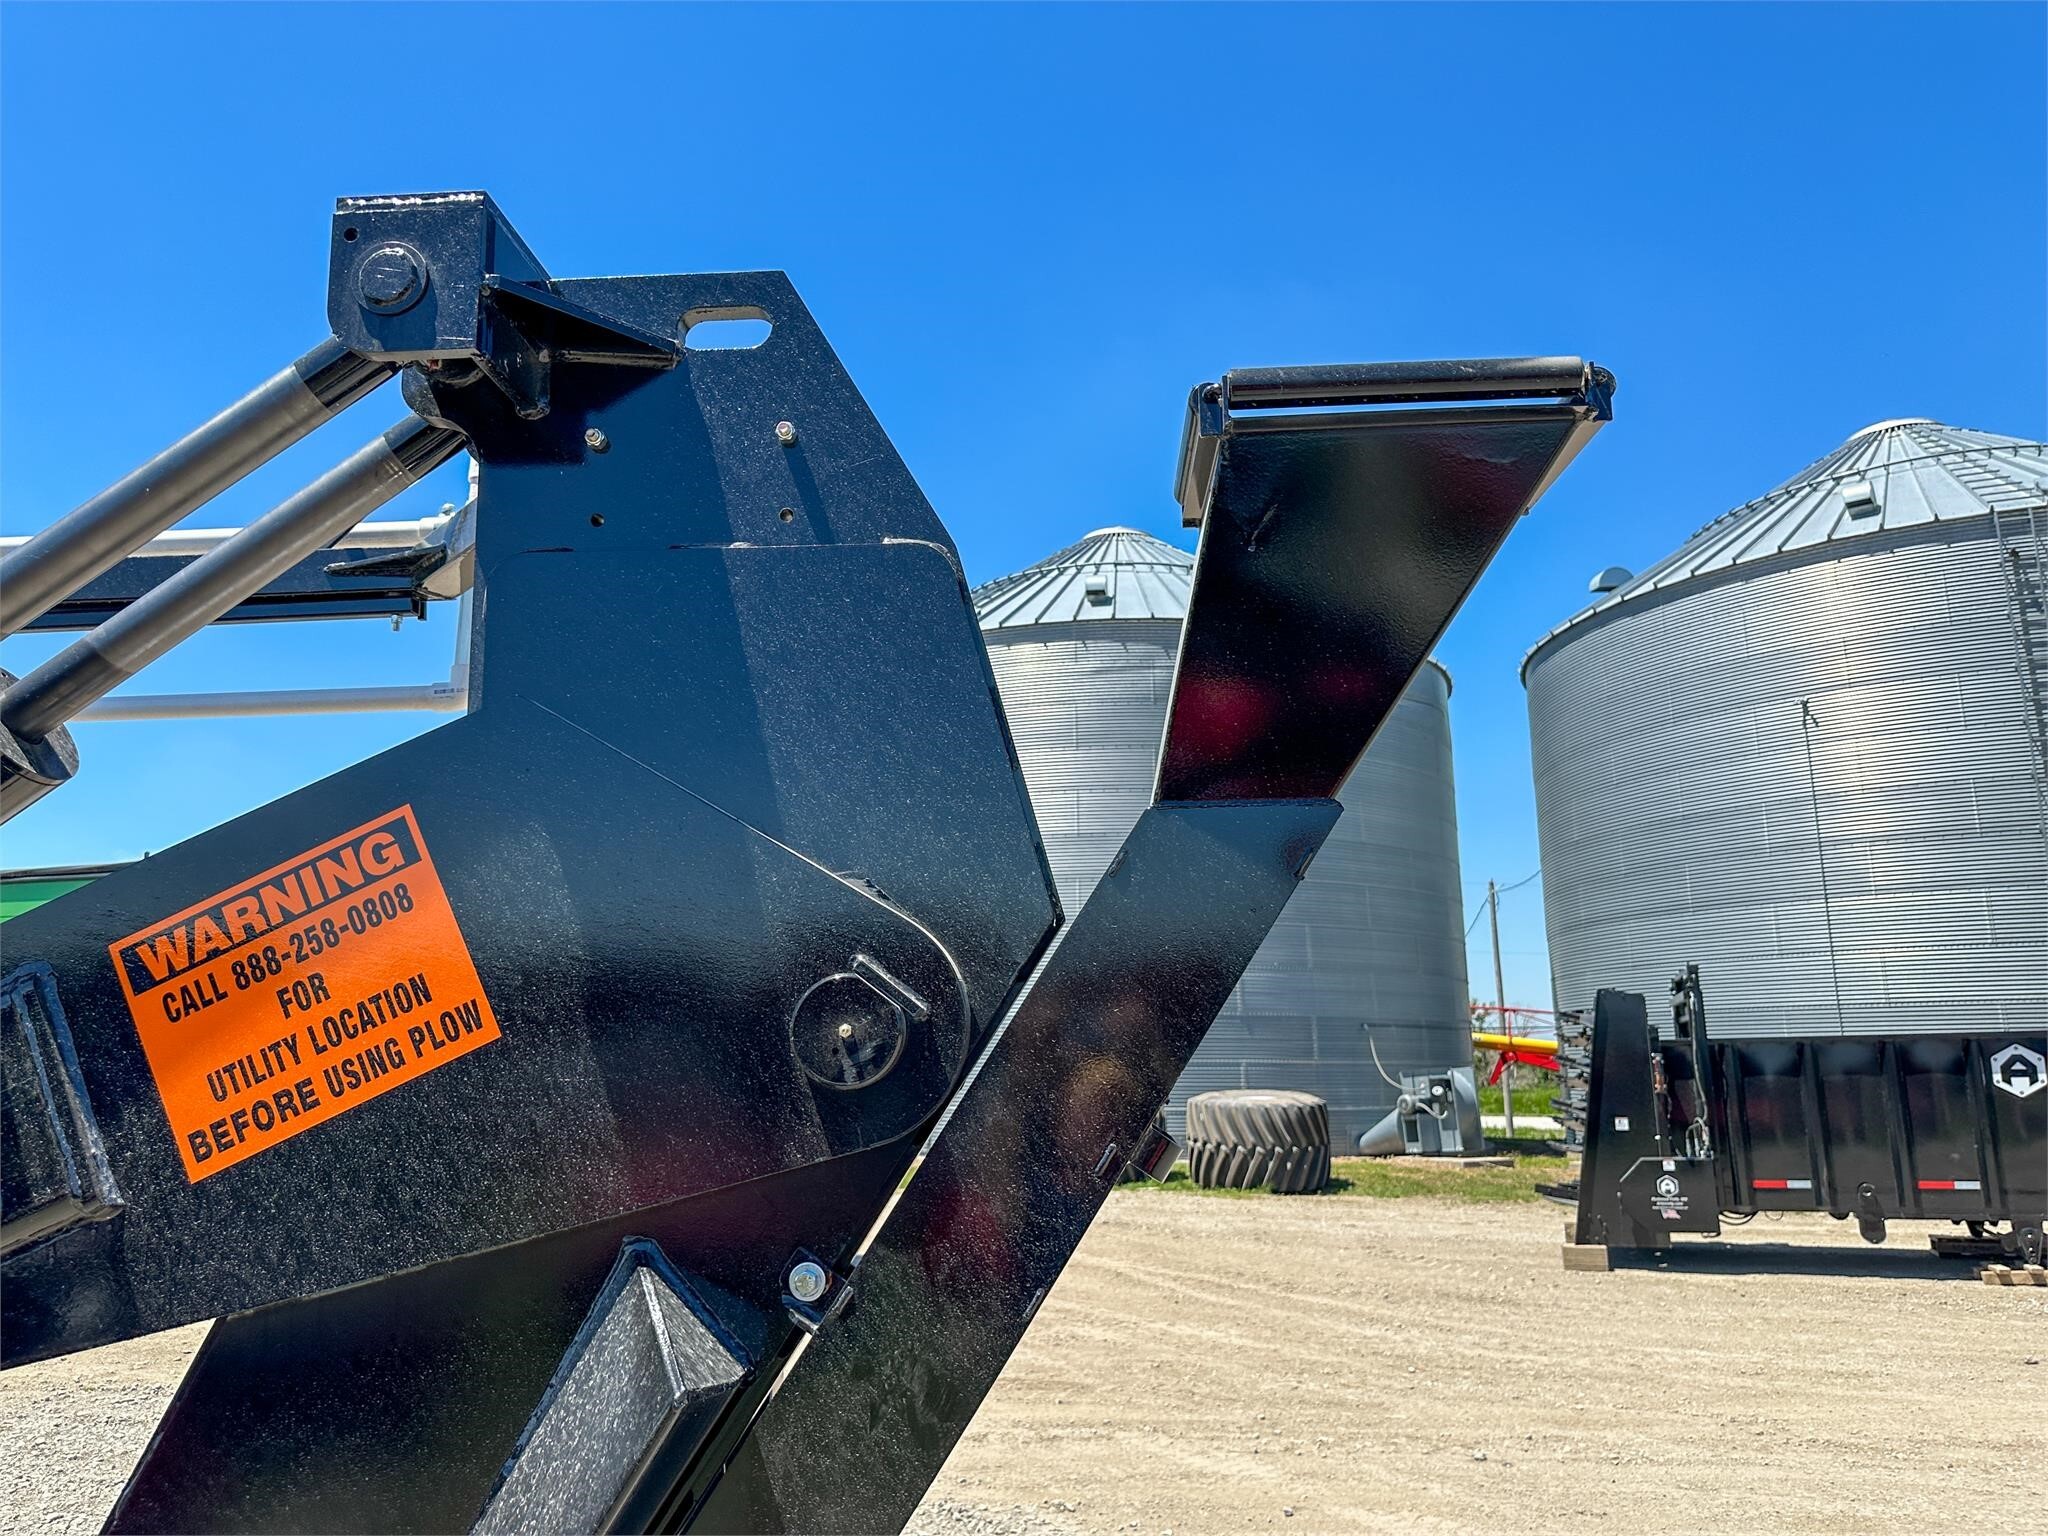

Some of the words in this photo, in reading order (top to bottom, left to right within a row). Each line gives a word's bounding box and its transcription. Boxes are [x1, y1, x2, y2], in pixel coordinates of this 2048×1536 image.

[135, 831, 407, 982] WARNING
[162, 971, 229, 1023] CALL
[230, 883, 415, 991] 888-258-0808
[206, 1034, 302, 1102] UTILITY
[306, 973, 433, 1056] LOCATION
[276, 971, 331, 1019] FOR
[187, 1077, 321, 1164] BEFORE
[323, 1040, 407, 1098] USING
[407, 998, 484, 1058] PLOW
